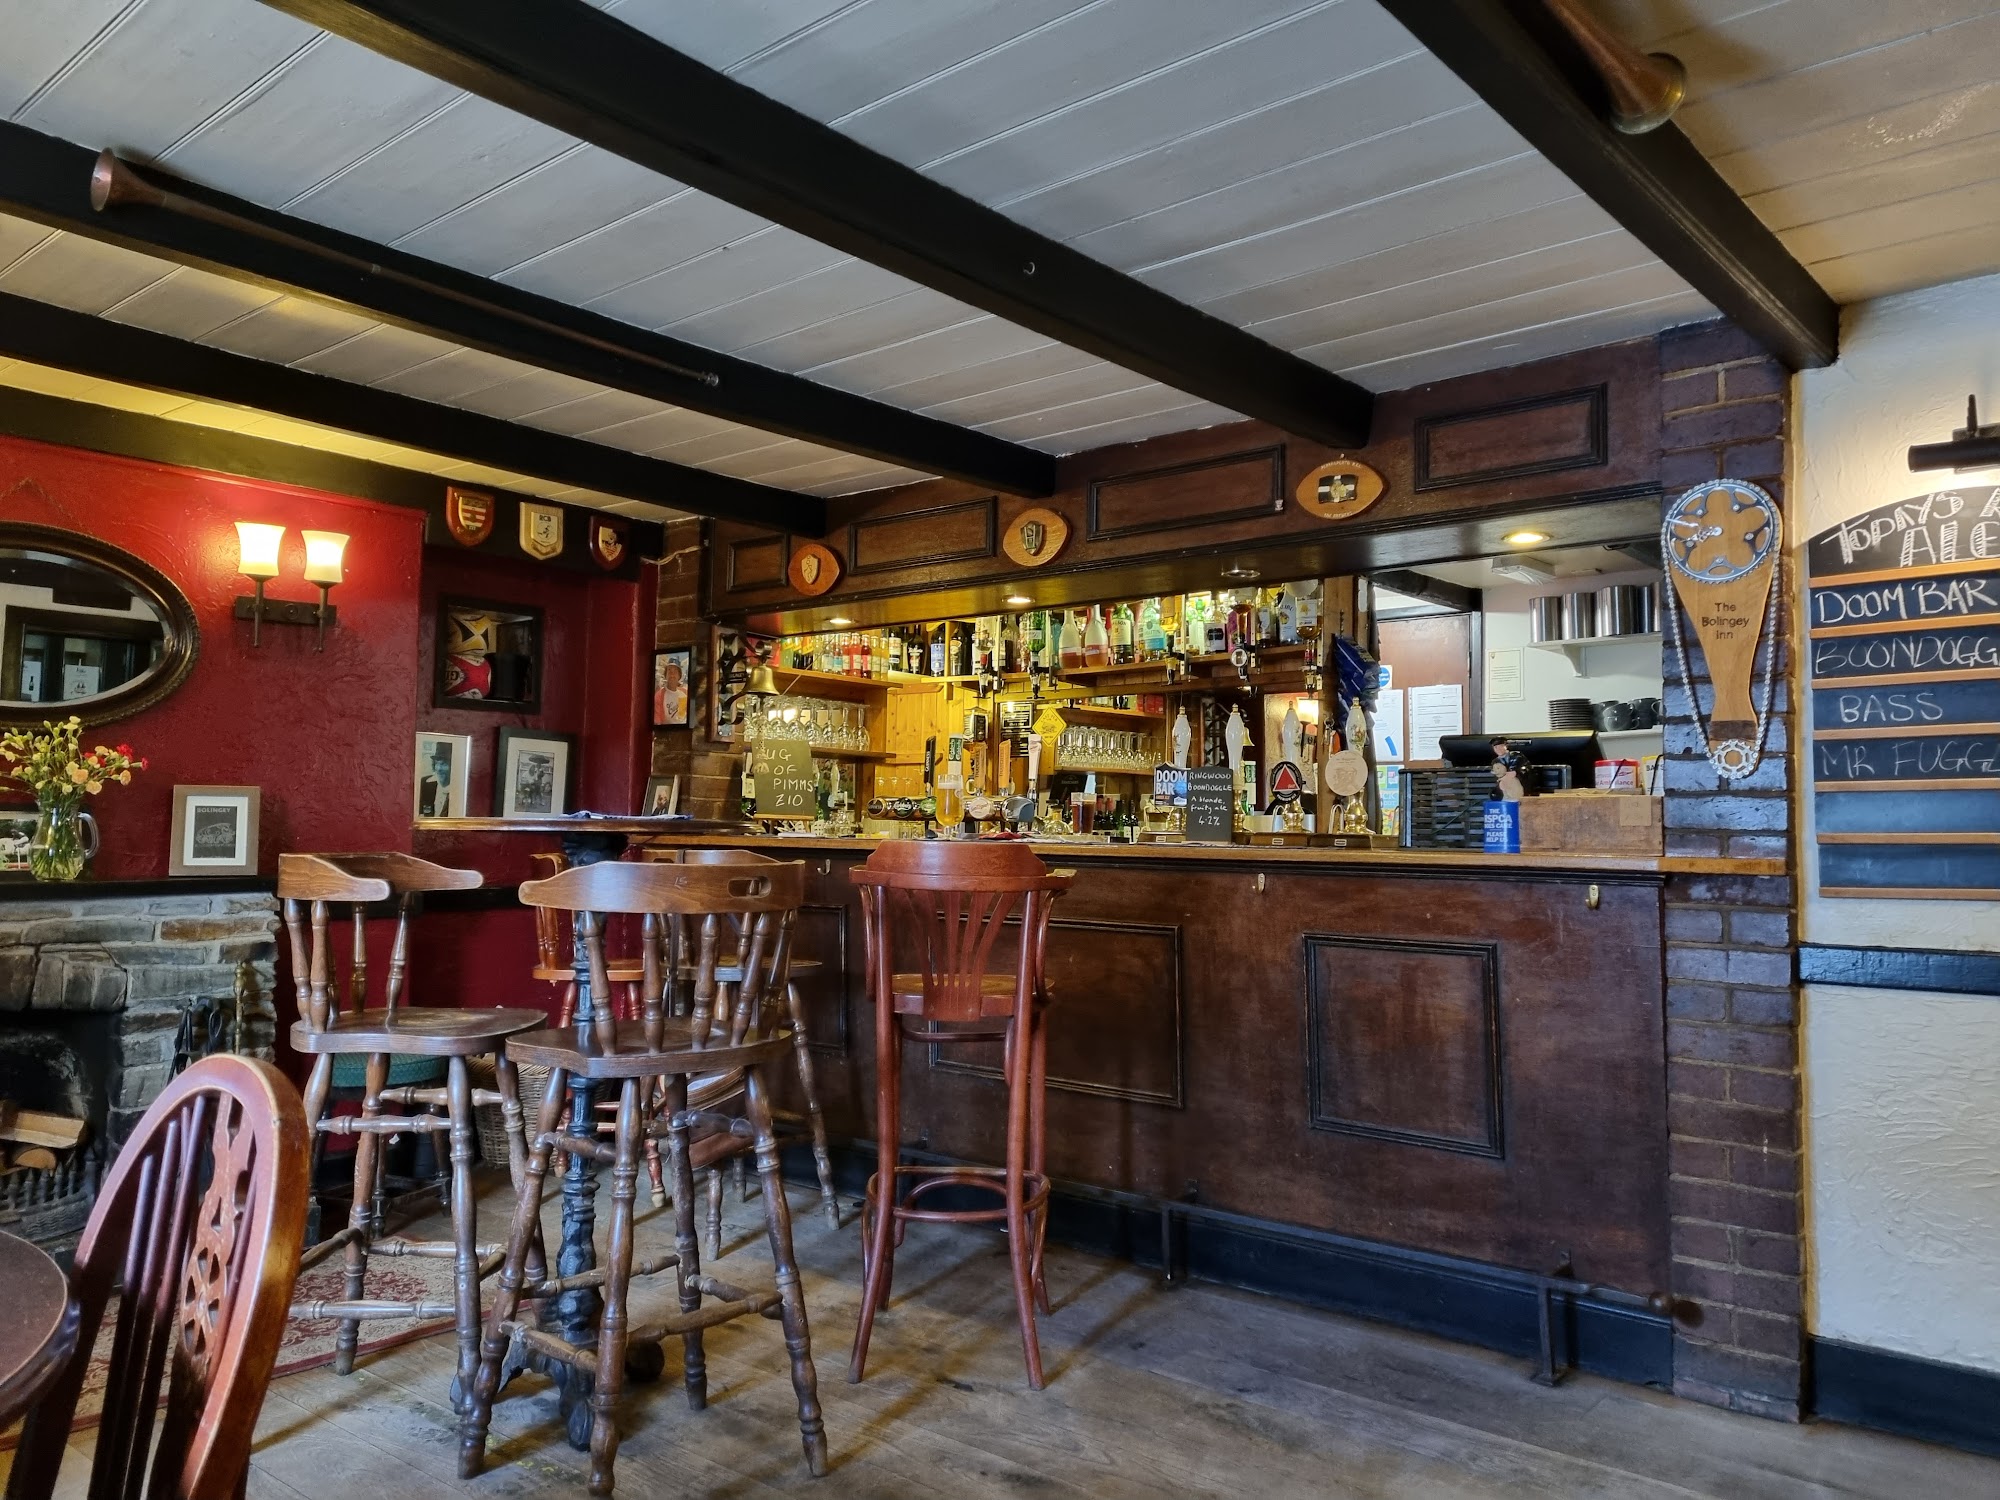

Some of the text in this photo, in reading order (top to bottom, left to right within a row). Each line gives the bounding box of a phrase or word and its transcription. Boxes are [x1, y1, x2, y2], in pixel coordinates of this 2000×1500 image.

[1714, 602, 1737, 612] The
[1815, 578, 1998, 623] DOOM BAR
[1701, 616, 1750, 628] Bolingey
[1716, 630, 1734, 640] Inn
[1815, 635, 2000, 674] BOONDOGG
[1839, 692, 1943, 723] BASS
[760, 748, 792, 761] UG
[1821, 745, 1875, 779] MR
[773, 764, 797, 775] OF
[1189, 772, 1231, 780] RINGWOOD
[1156, 770, 1187, 783] DOOM
[773, 778, 814, 792] PIMMS
[1156, 782, 1175, 795] BAR
[1190, 804, 1212, 815] fruity
